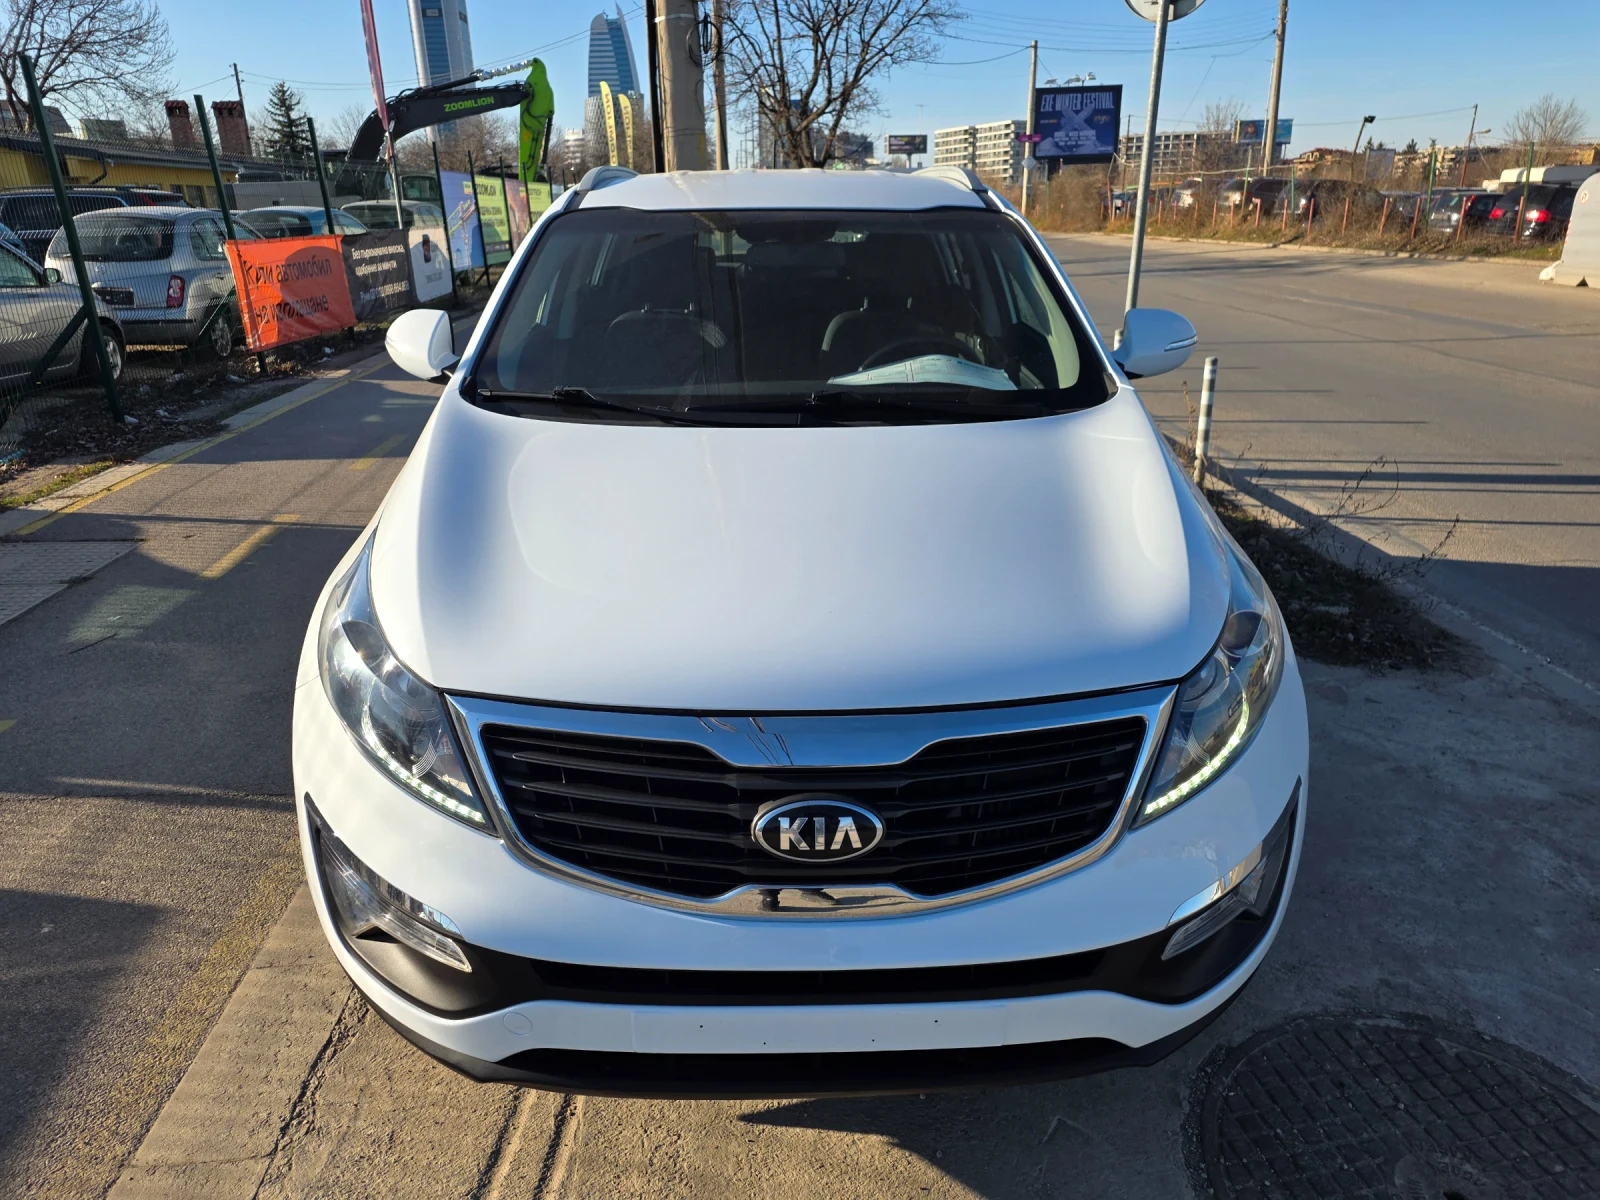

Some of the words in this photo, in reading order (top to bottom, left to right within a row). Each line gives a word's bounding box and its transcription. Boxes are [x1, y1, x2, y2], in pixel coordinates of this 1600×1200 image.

[443, 96, 495, 112] ZOOMLION
[276, 254, 333, 282] автомобил
[254, 305, 271, 325] на
[778, 816, 863, 851] KIA
